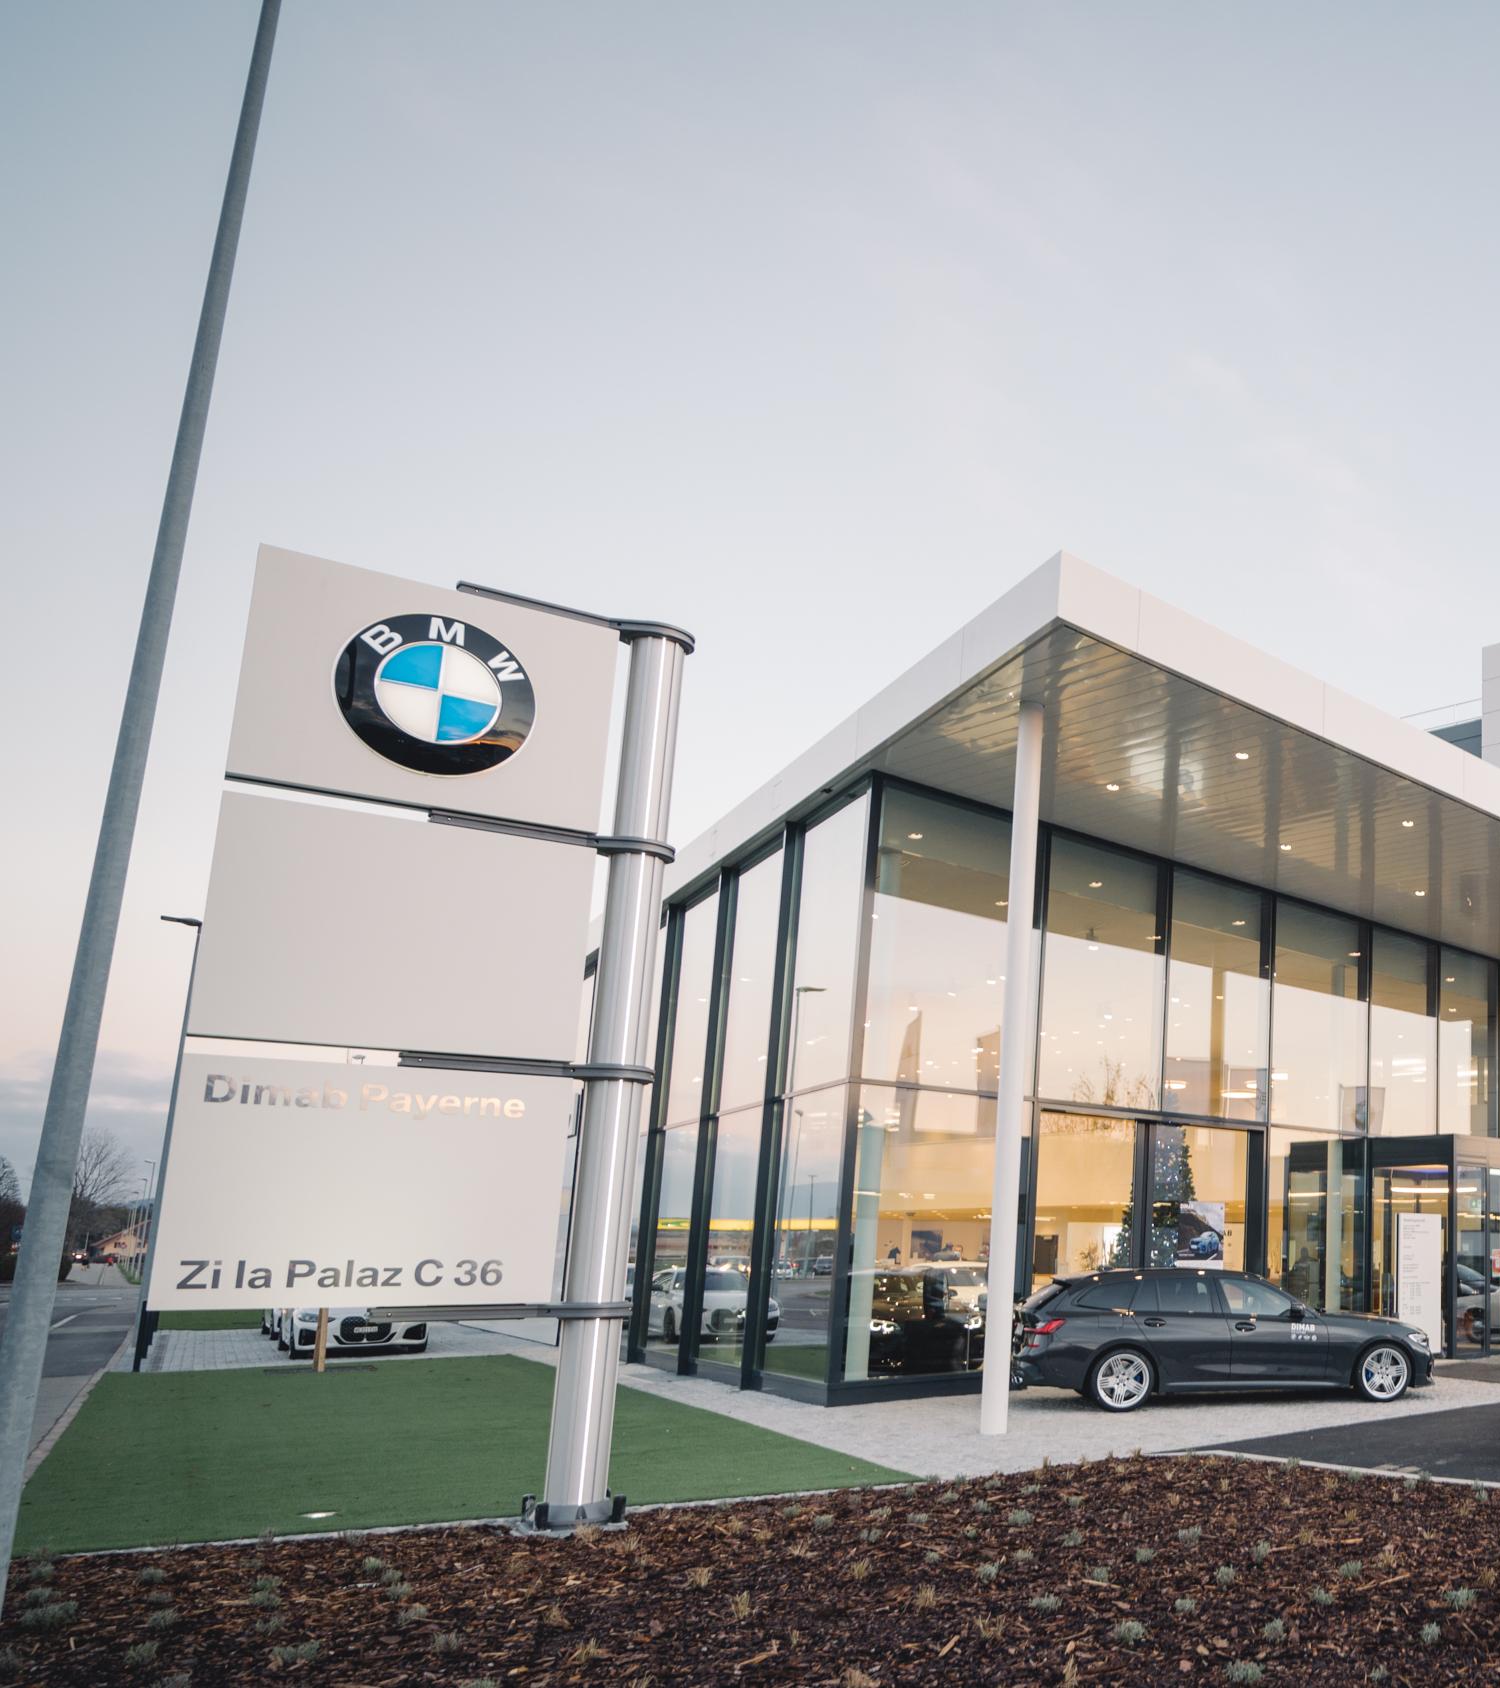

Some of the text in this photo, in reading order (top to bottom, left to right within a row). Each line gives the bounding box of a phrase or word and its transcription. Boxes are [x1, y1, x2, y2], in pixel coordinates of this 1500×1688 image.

[360, 616, 525, 682] BMW
[203, 1074, 526, 1120] Dimab Payerne
[176, 1259, 503, 1290] Zi la Palaz C 36
[1291, 1323, 1316, 1332] DIMAB
